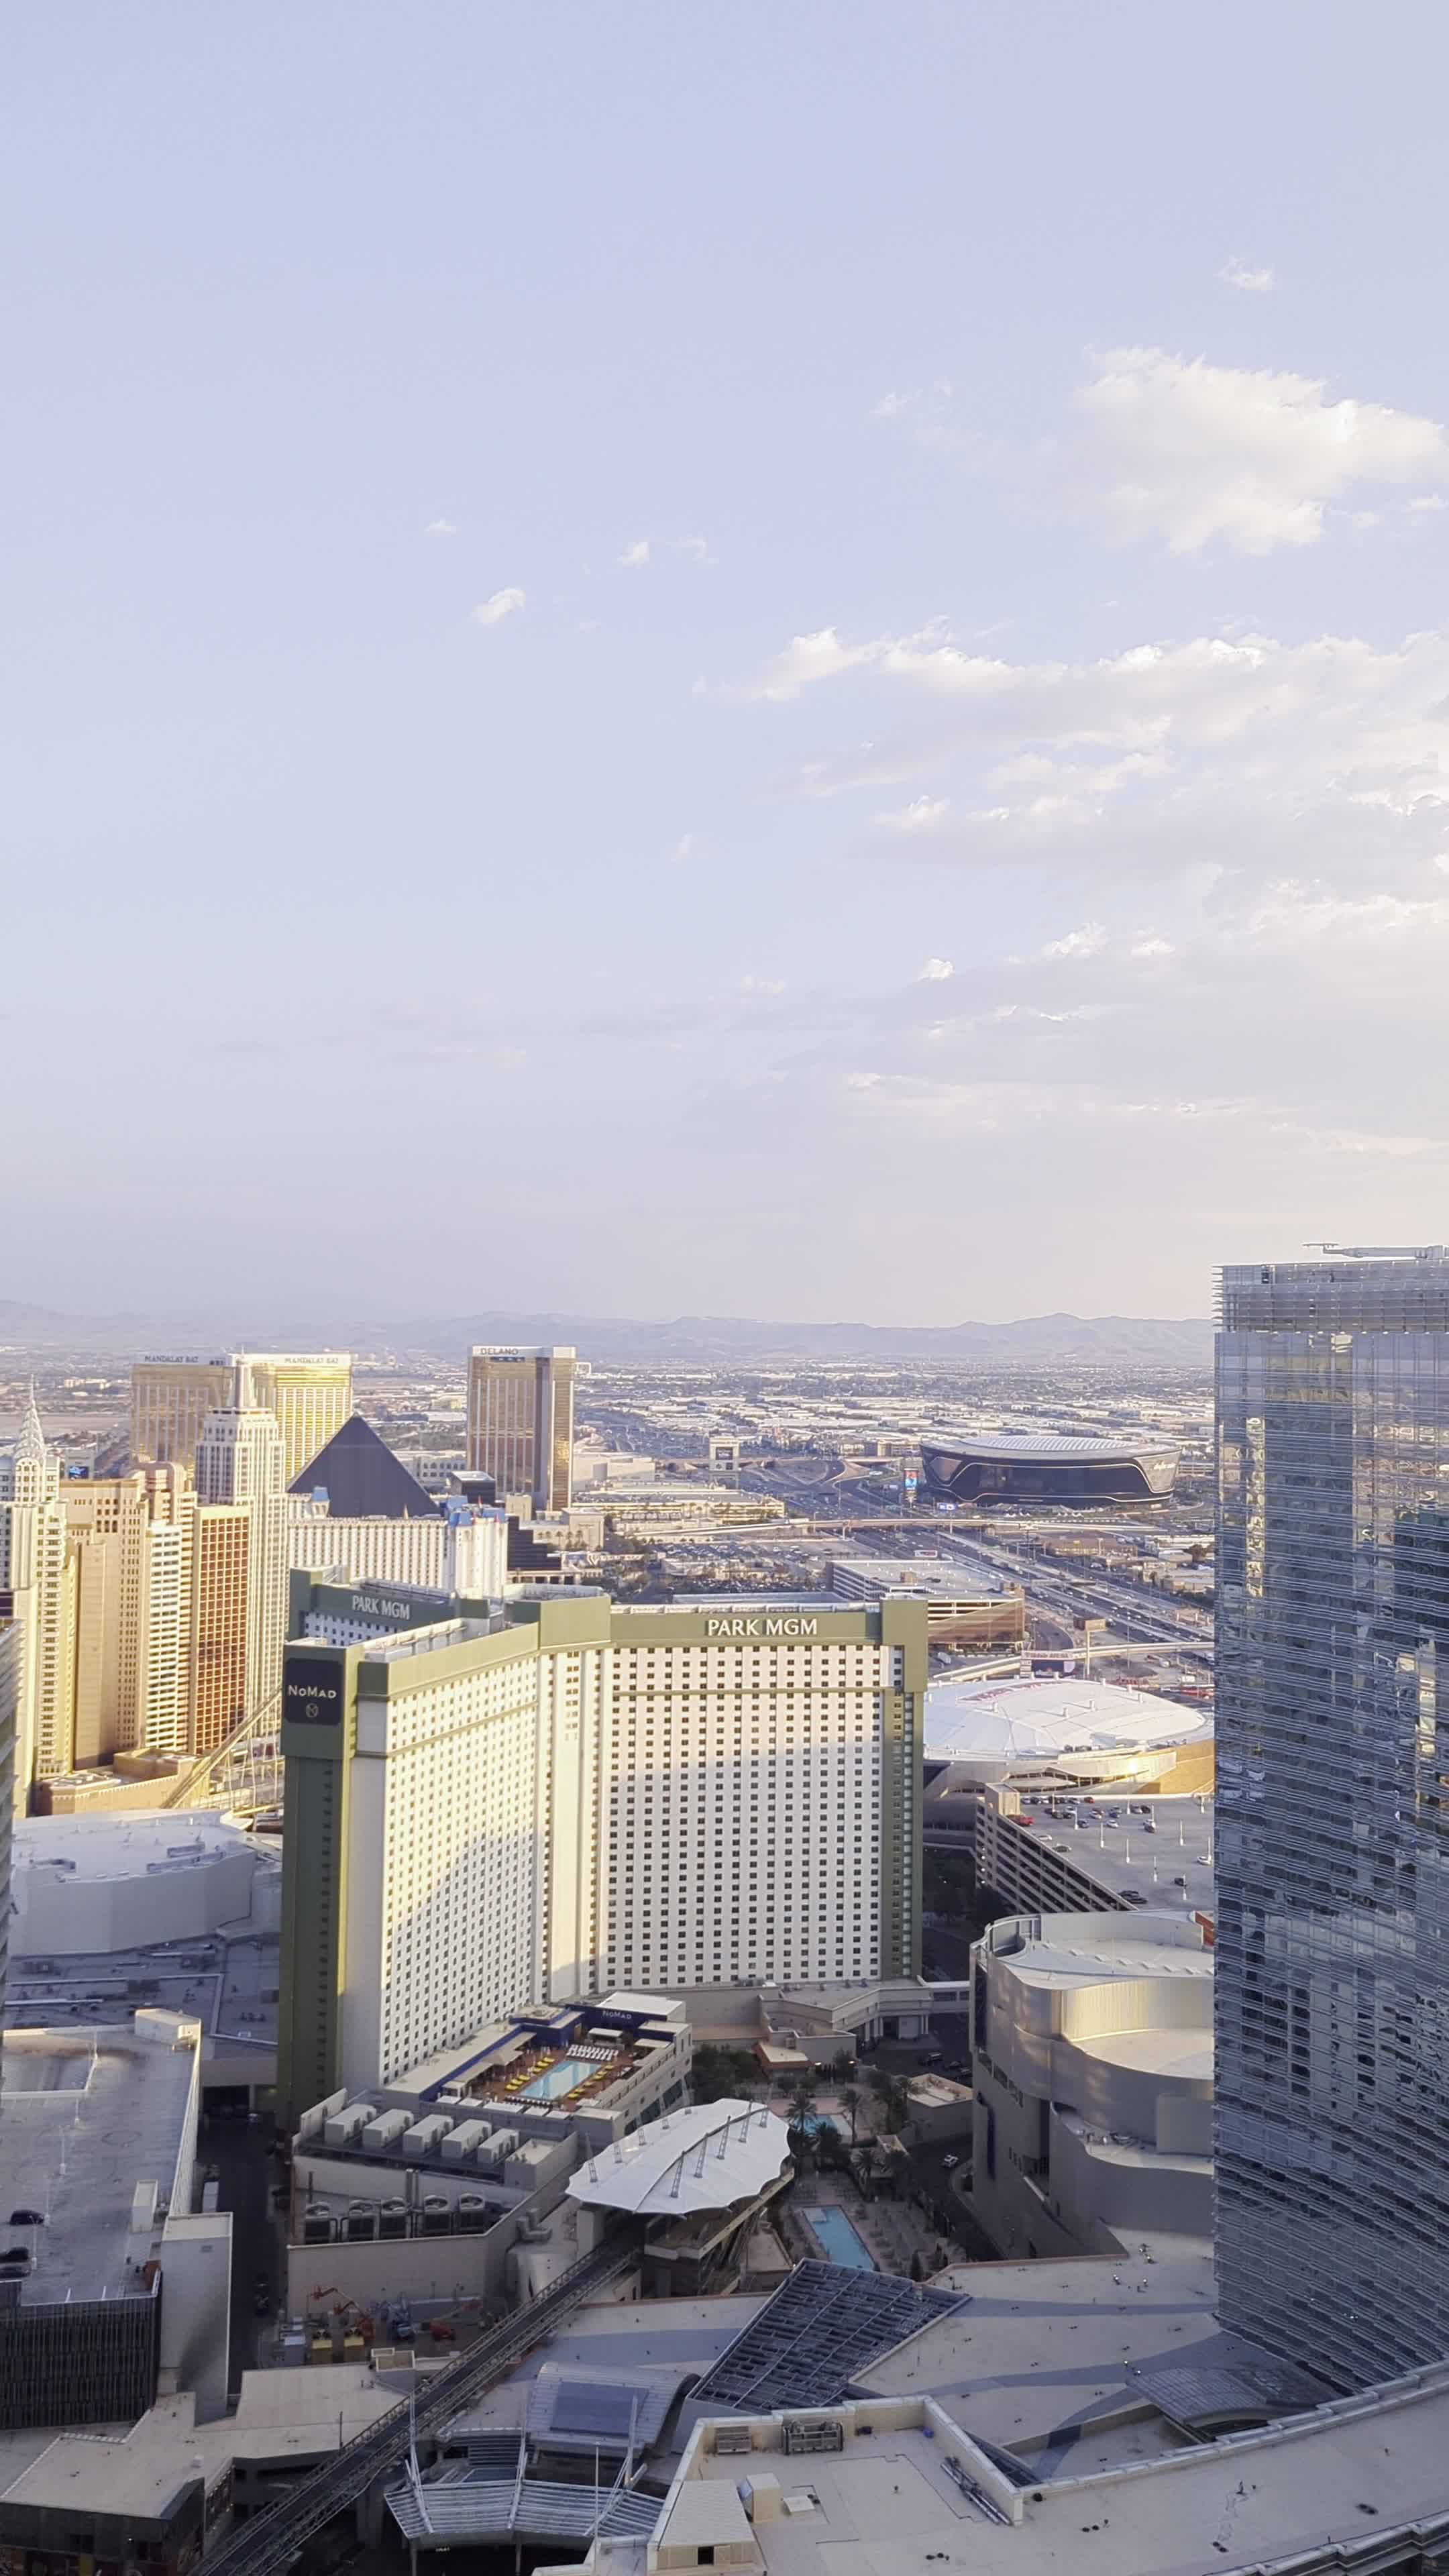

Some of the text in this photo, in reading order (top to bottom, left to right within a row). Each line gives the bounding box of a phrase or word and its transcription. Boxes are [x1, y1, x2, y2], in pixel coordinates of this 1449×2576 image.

[352, 1595, 411, 1621] PARK MGM
[707, 1618, 818, 1636] PARK MGM
